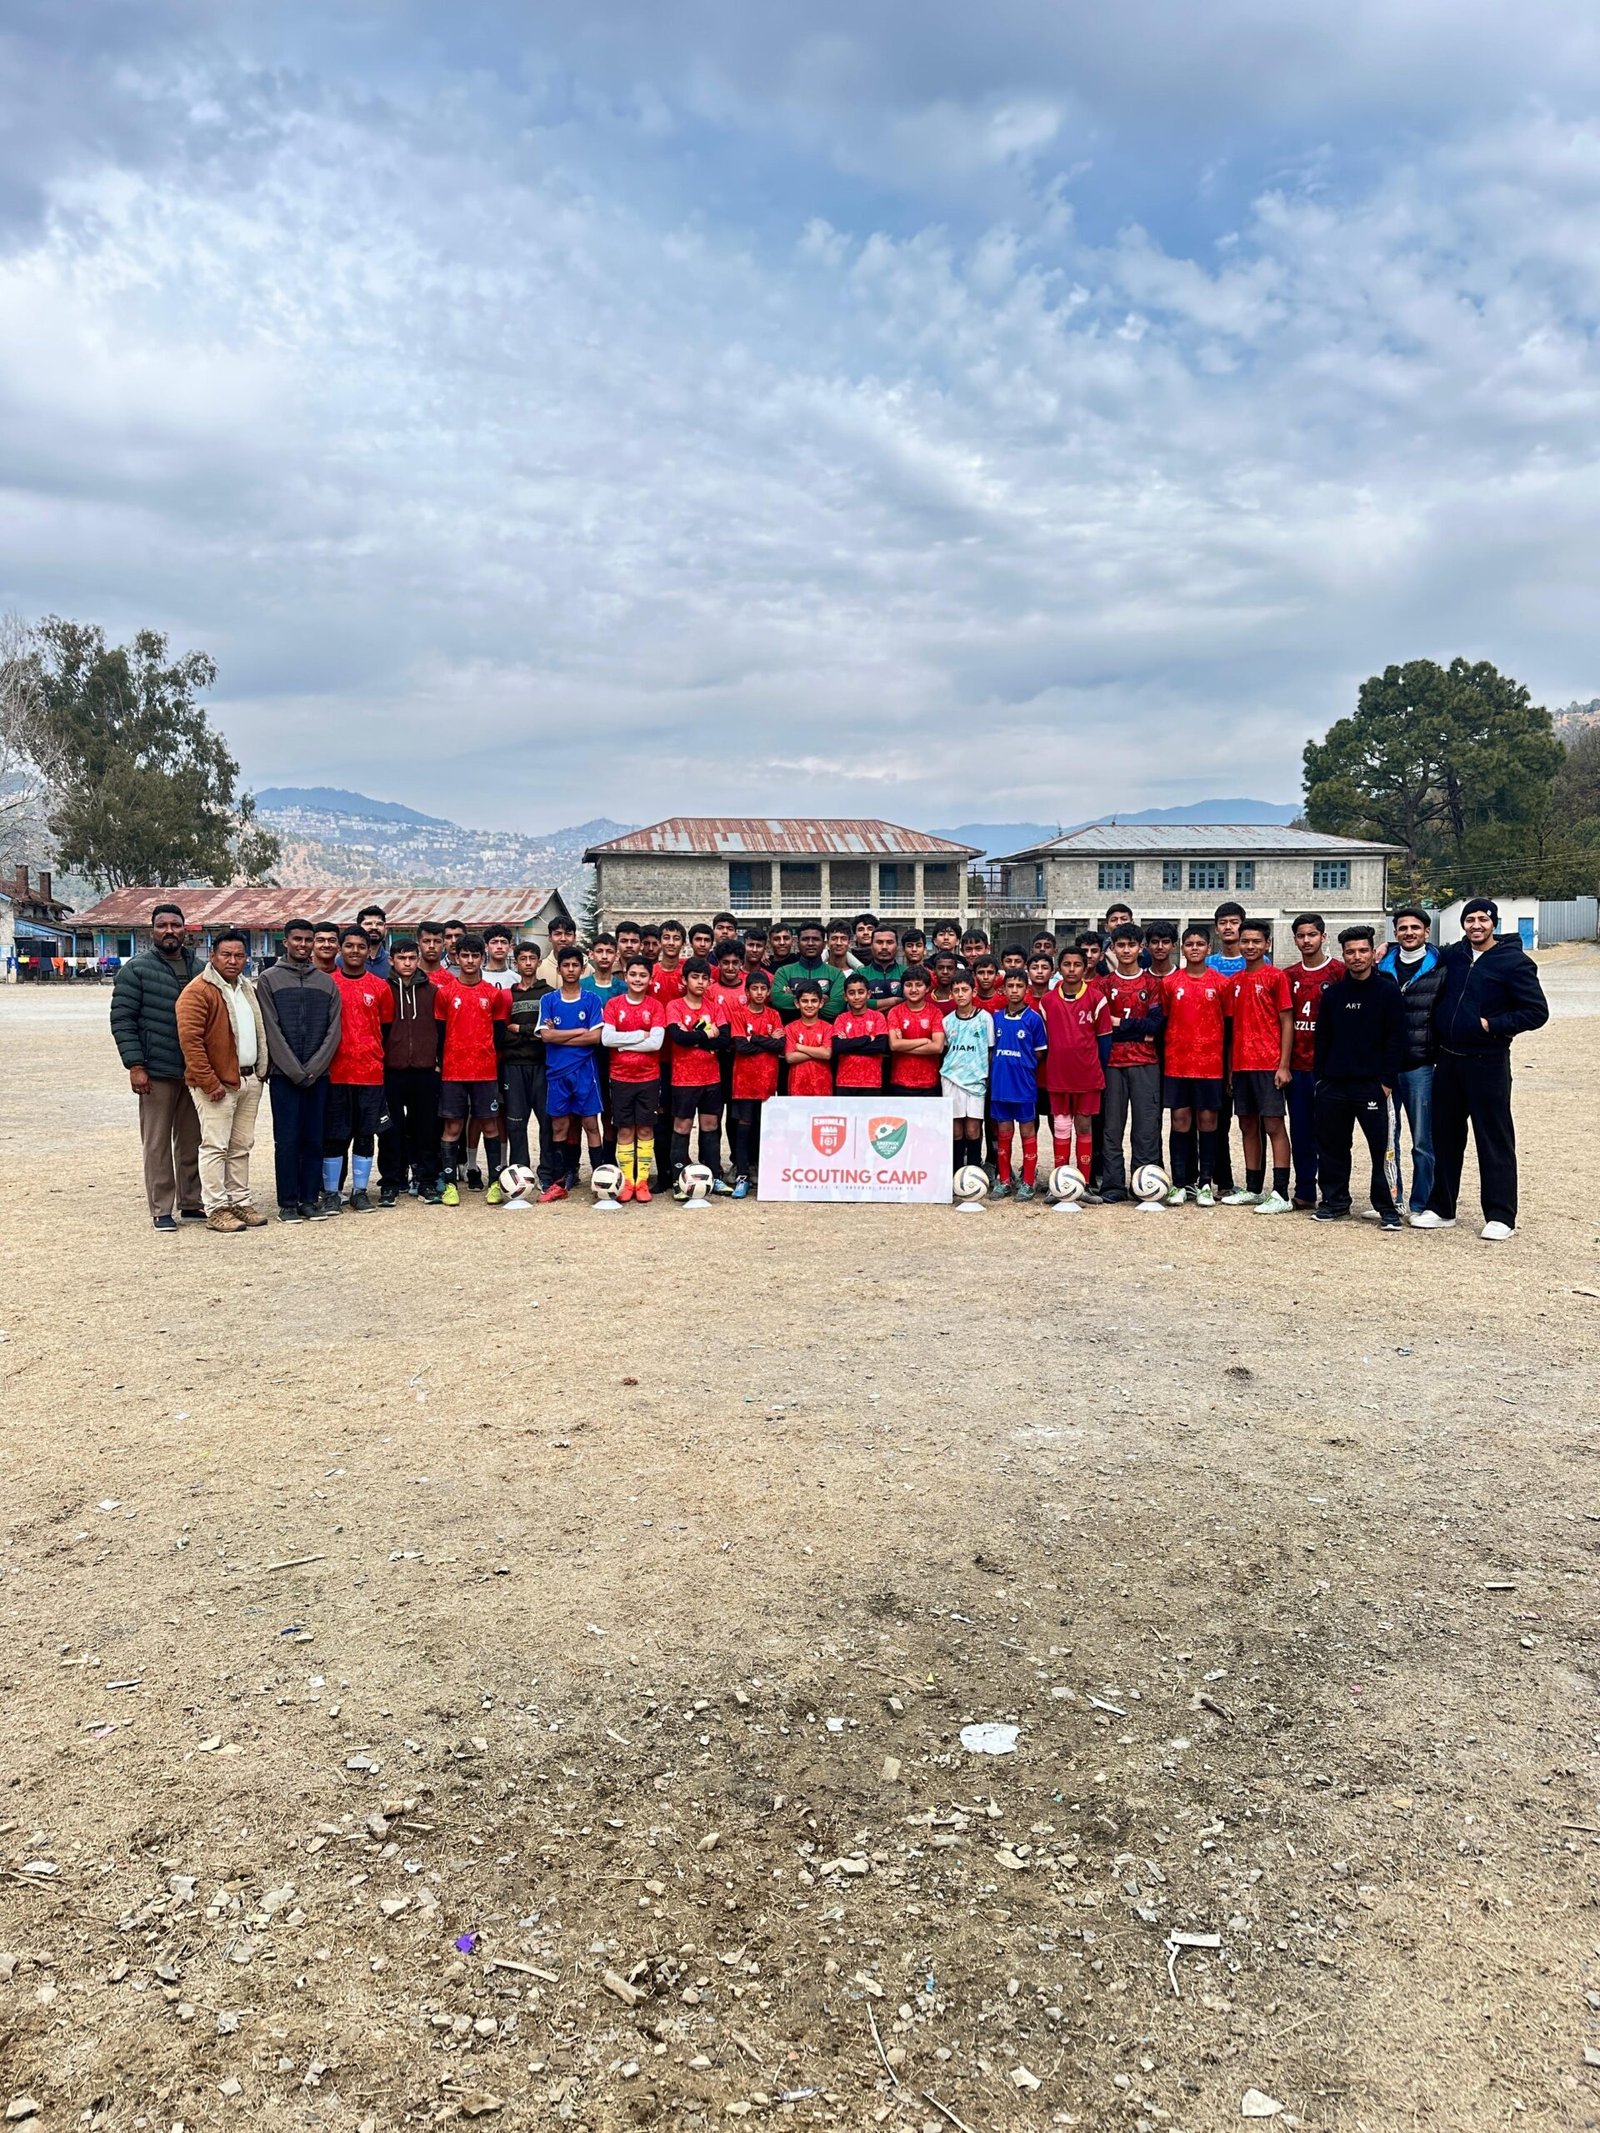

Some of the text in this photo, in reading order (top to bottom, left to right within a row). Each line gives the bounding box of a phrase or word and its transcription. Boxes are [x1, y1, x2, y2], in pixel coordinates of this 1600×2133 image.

[1123, 1008, 1131, 1020] 7
[1301, 1001, 1311, 1017] 4
[1078, 1010, 1093, 1025] 24
[1294, 1021, 1316, 1031] ZZLE
[781, 1168, 928, 1185] SCOUTING CAMP
